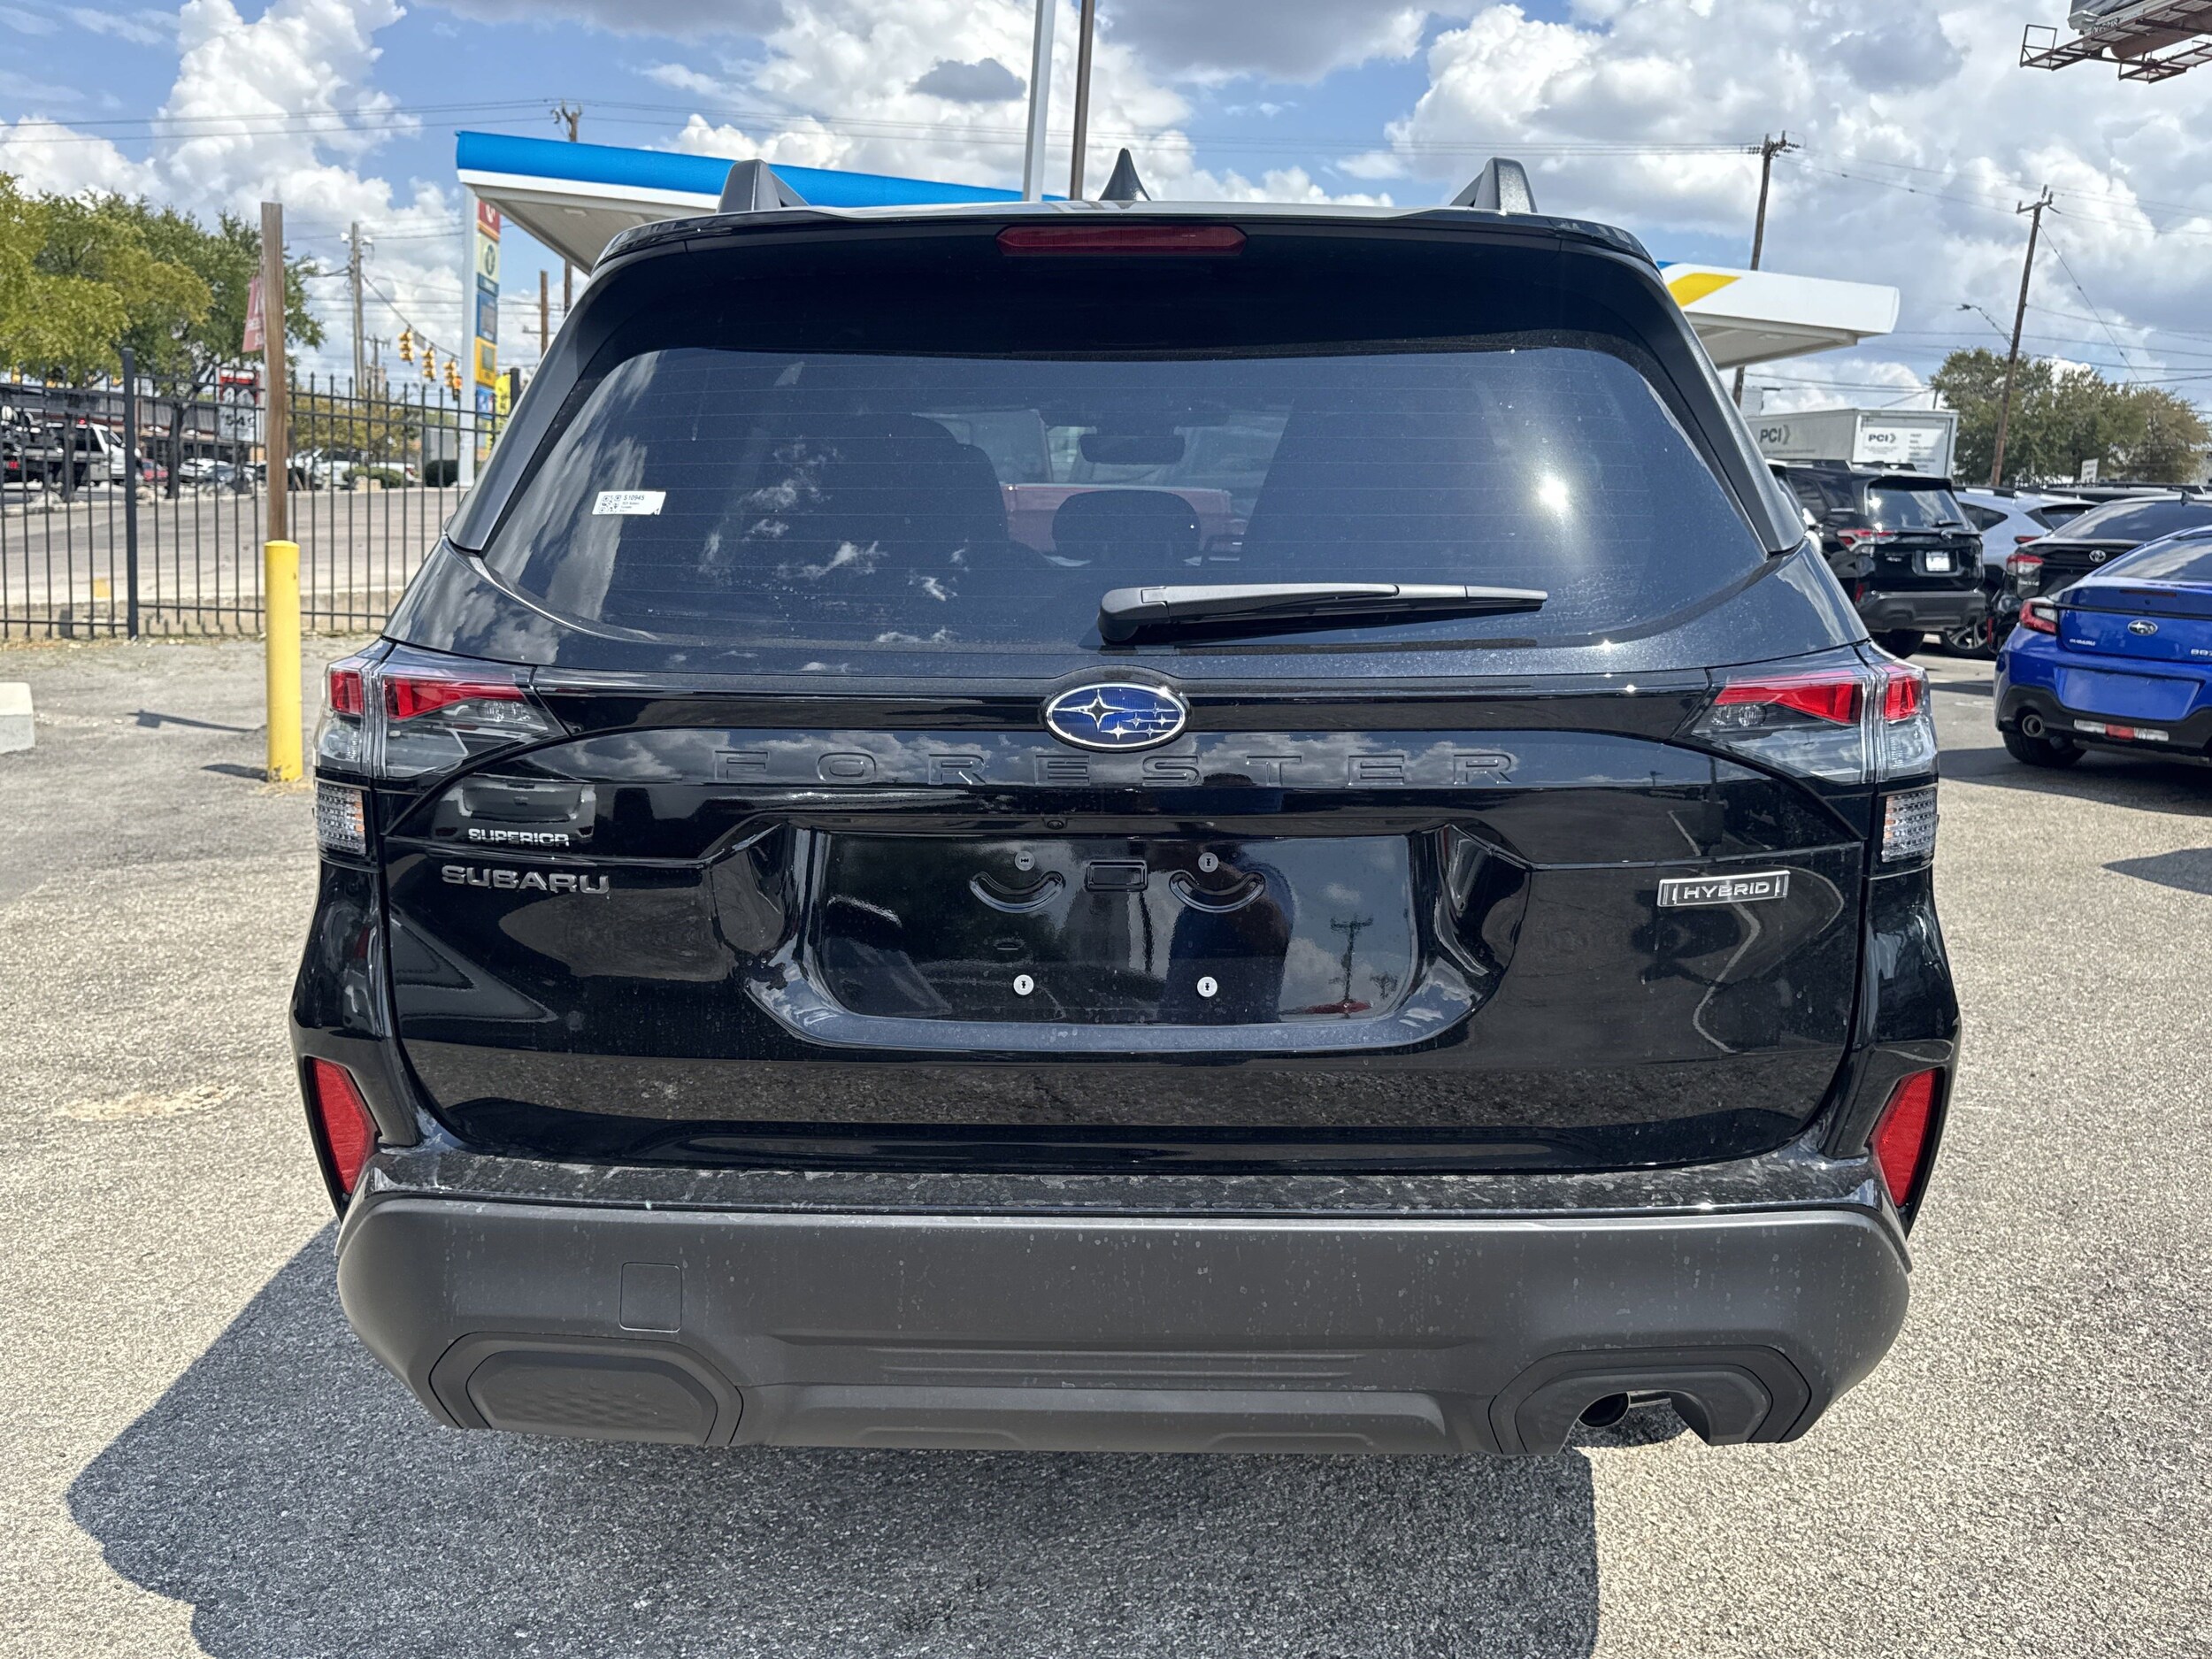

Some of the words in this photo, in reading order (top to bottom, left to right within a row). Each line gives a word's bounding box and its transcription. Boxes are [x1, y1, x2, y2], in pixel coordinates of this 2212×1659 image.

[1760, 426, 1781, 443] PCI
[1868, 434, 1888, 442] PCI
[713, 749, 1515, 786] FORESTER
[468, 827, 570, 847] SUPERIOR
[441, 864, 611, 895] SUBARU
[1683, 881, 1770, 899] HYBRID
